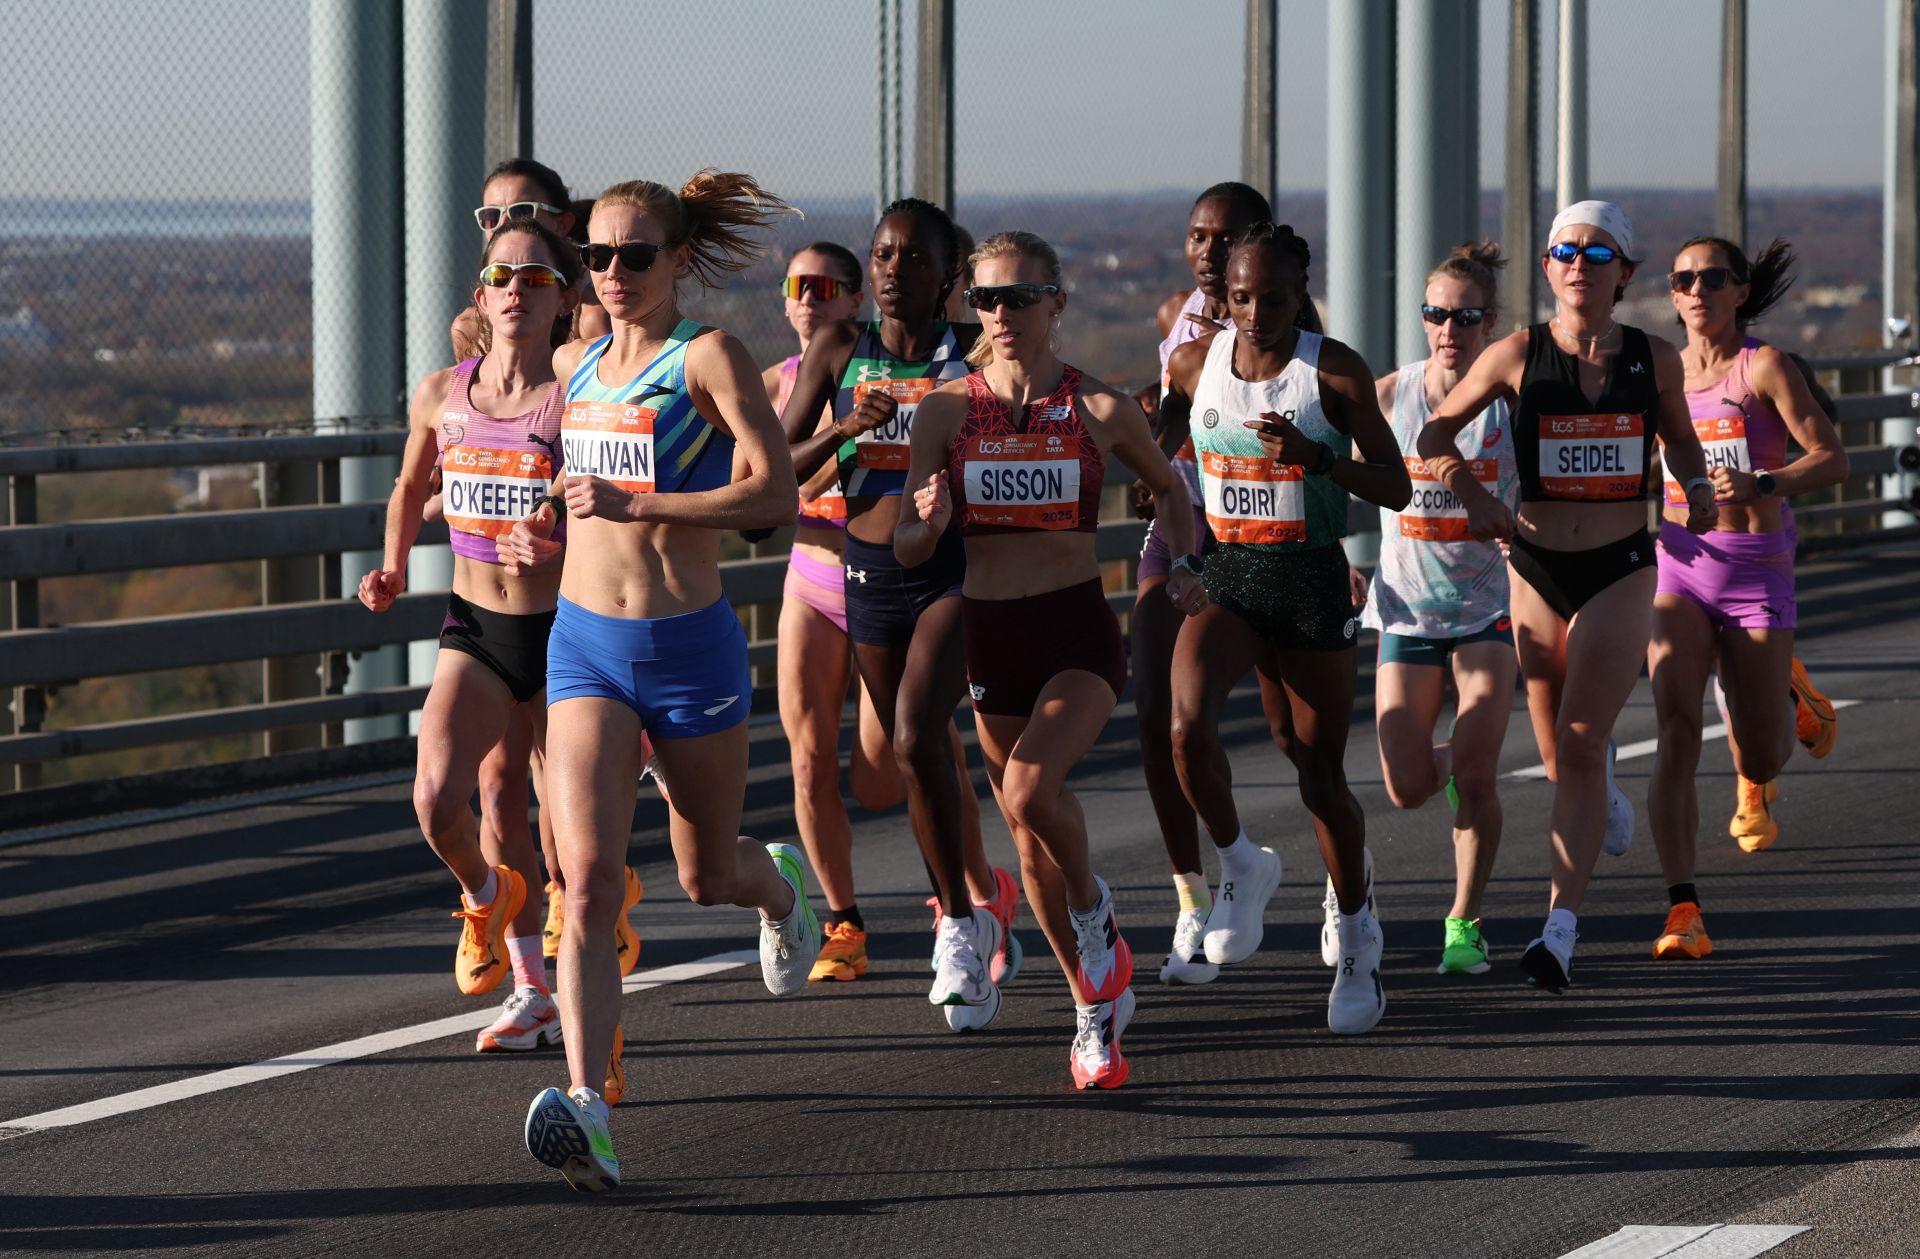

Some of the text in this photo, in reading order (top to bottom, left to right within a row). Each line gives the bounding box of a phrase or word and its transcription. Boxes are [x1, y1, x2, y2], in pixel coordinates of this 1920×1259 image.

[1552, 419, 1574, 432] tcs
[979, 439, 1002, 454] tcs
[455, 449, 477, 466] tcs
[564, 438, 649, 477] SULLIVAN
[1211, 455, 1228, 472] tcs
[1558, 444, 1625, 473] SEIDEL
[981, 468, 1062, 500] SISSON
[1223, 486, 1276, 517] OBIRI
[1042, 510, 1073, 522] 2025
[1267, 527, 1299, 537] 2025
